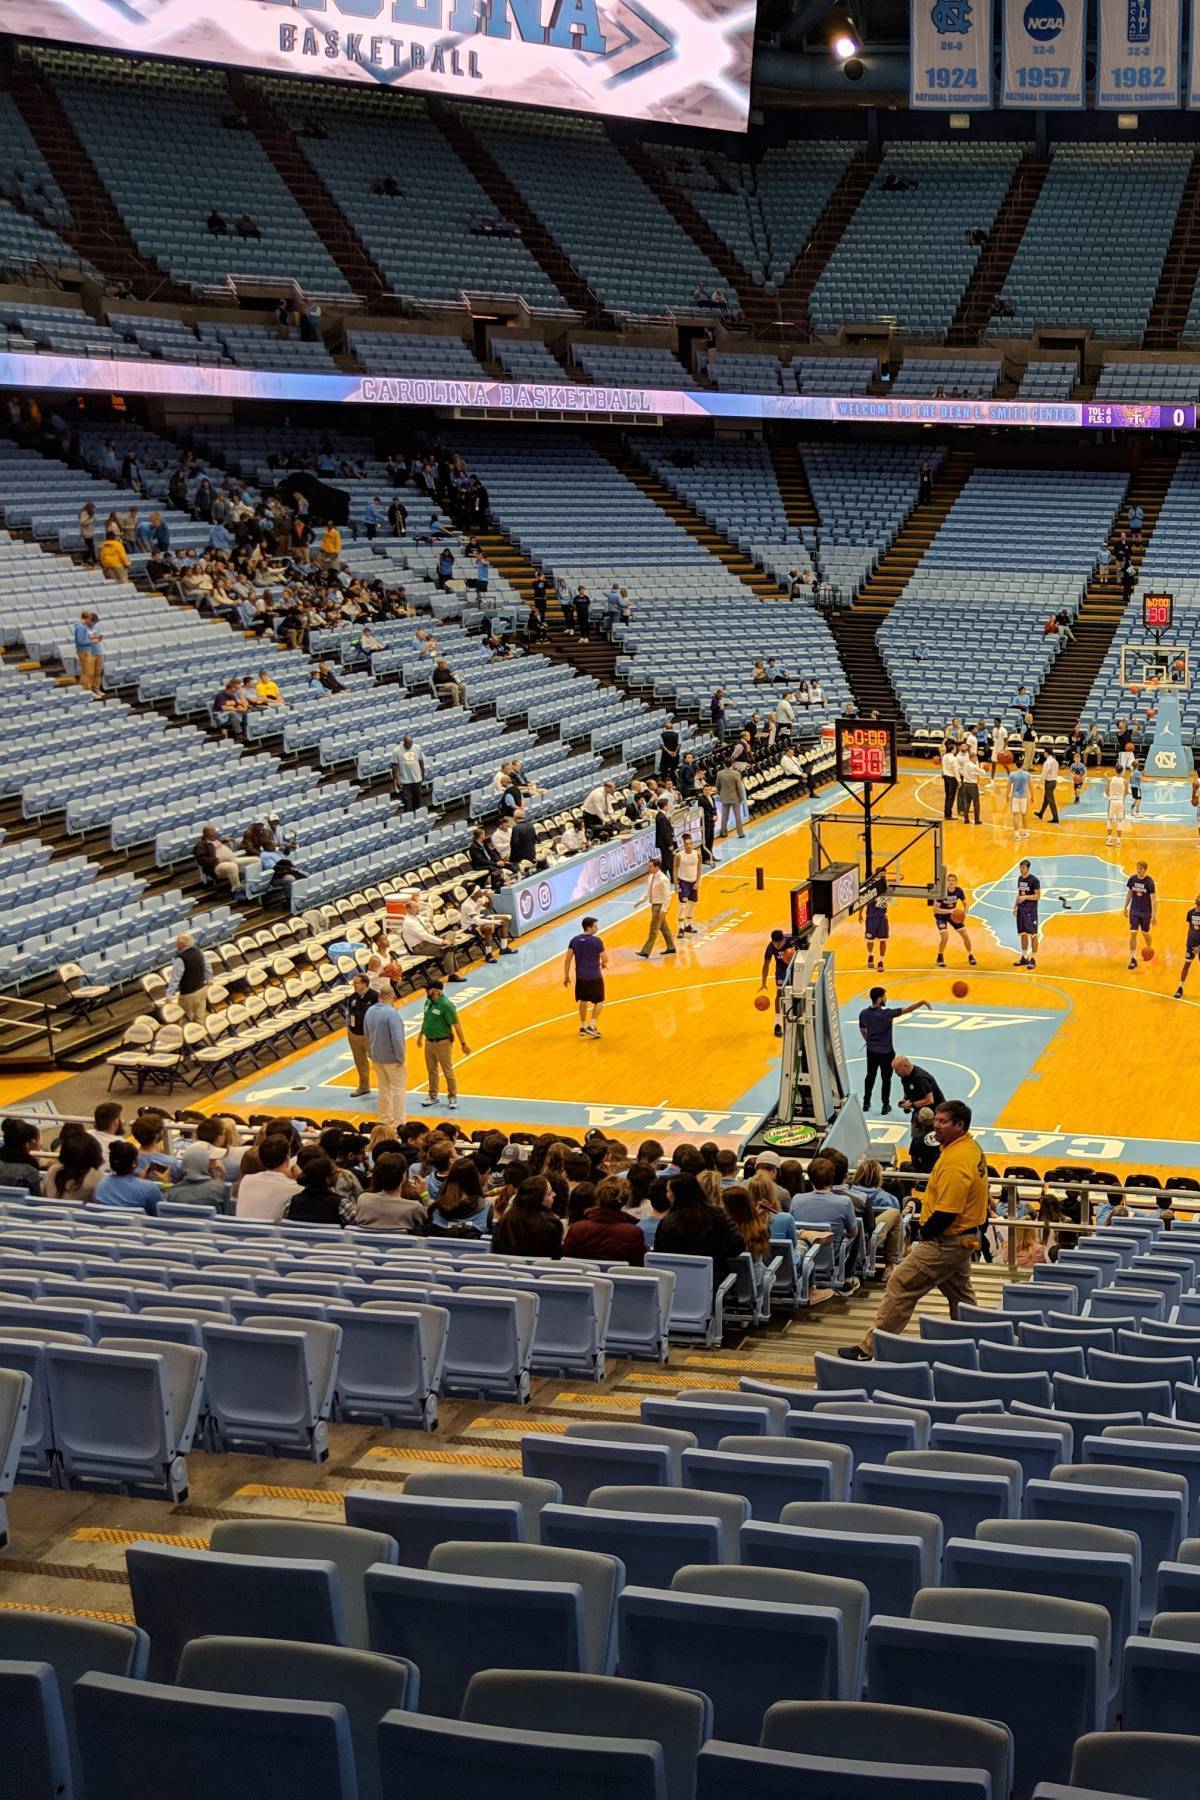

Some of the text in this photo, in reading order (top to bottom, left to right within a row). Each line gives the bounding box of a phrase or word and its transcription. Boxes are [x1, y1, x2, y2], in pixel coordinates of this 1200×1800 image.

[1028, 18, 1065, 30] NCAA
[279, 23, 483, 79] BASKETBALL
[926, 67, 978, 89] 1924
[1016, 67, 1072, 88] 1957
[1111, 66, 1167, 88] 1982
[360, 378, 651, 411] CAROLINA BASKETBALL
[839, 403, 893, 417] WELCOME
[916, 405, 936, 418] THE
[990, 407, 1029, 420] SMITH
[1031, 407, 1075, 421] CENTER
[1173, 409, 1185, 426] 0
[1149, 608, 1167, 623] 30
[852, 747, 883, 776] 30
